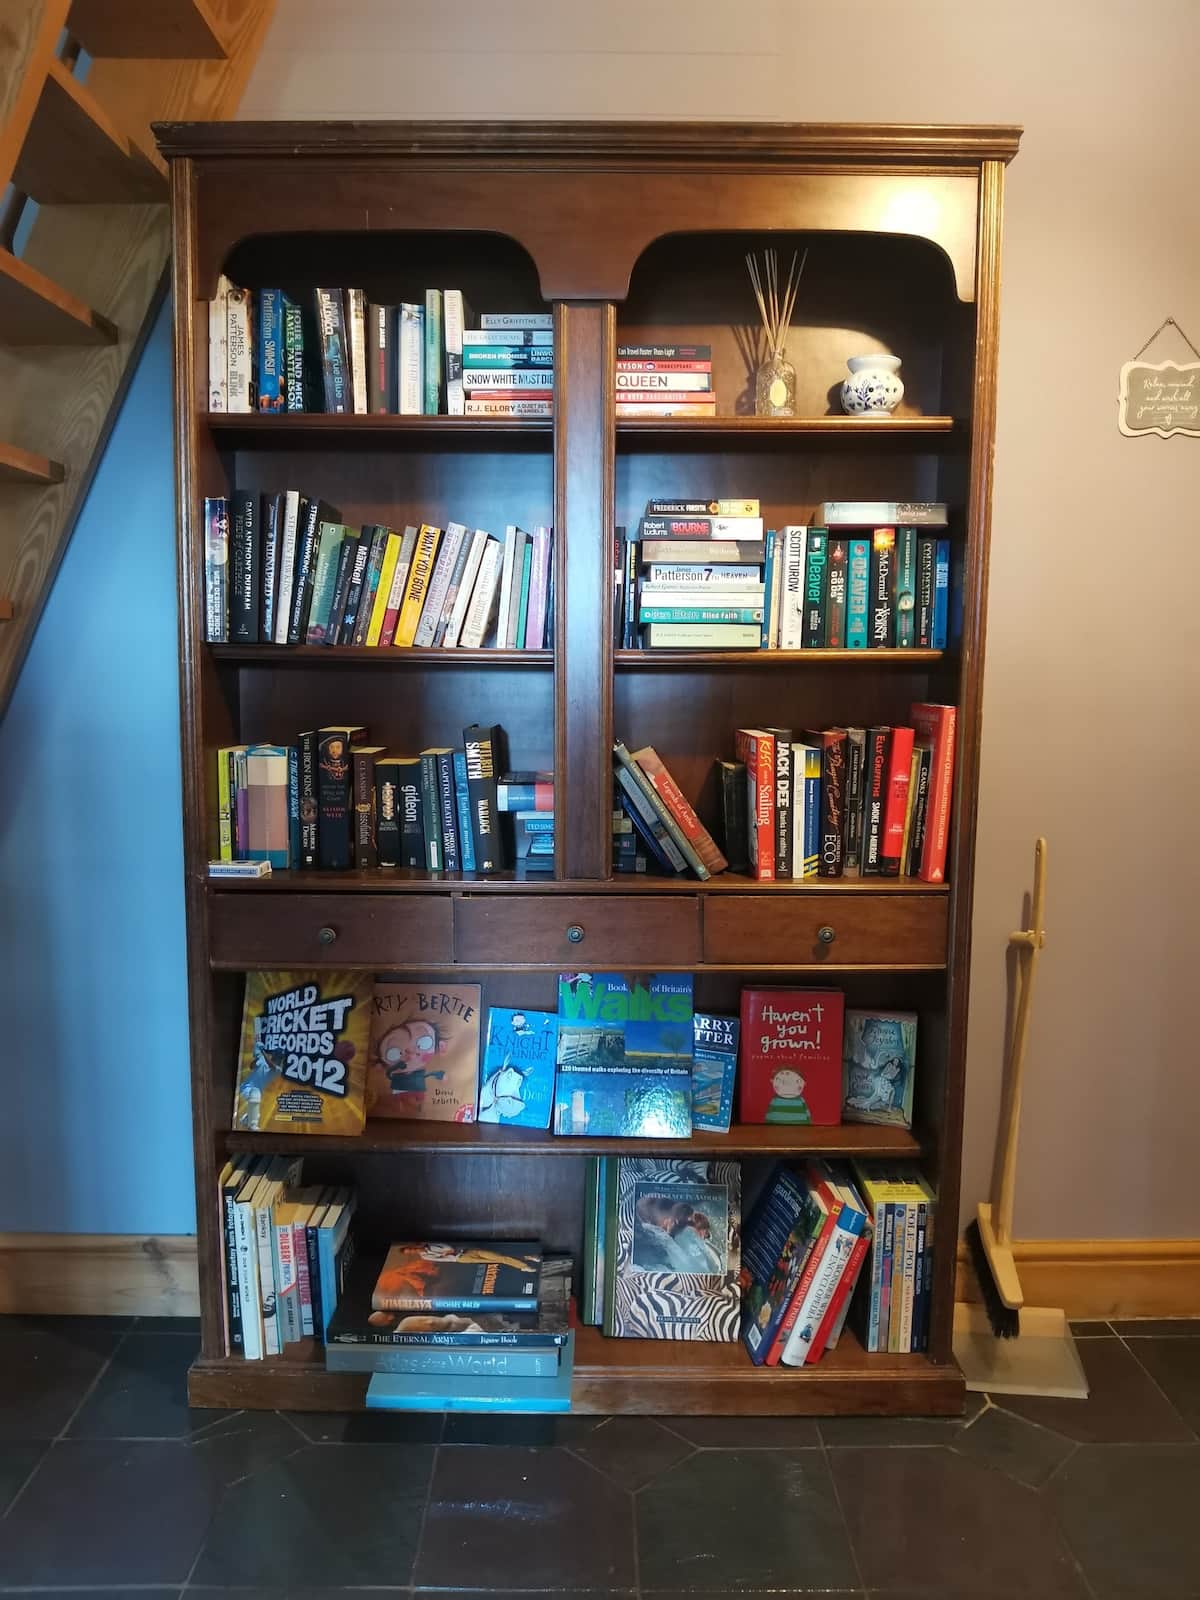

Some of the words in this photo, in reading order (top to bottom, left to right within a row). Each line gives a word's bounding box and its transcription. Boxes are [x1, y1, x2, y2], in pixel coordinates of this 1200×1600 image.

[264, 294, 276, 338] Patterson
[286, 309, 295, 344] JAMES
[294, 309, 302, 338] FOUR
[230, 314, 238, 366] PATTERSON
[264, 340, 276, 376] SWIMSUIT
[294, 344, 303, 378] BLIND
[288, 348, 296, 410] PATTERSON
[334, 376, 343, 398] Blue
[466, 374, 490, 384] SNOW
[492, 374, 517, 384] WHITE
[518, 374, 540, 384] MUST
[542, 374, 552, 384] DIE
[618, 376, 668, 387] QUEEN
[294, 381, 304, 410] MICE
[306, 506, 318, 538] STEPHEN
[672, 522, 709, 531] BOURNE
[302, 538, 313, 574] HAWKING
[422, 530, 436, 559] WANT
[790, 531, 801, 560] SCOTT
[923, 543, 931, 570] COLIN
[264, 541, 276, 597] KIDNAPPED
[352, 546, 367, 585] Mankell
[416, 559, 429, 578] YOU
[655, 568, 702, 581] Patterson
[788, 563, 800, 592] TUROW
[808, 550, 825, 604] Deaver
[878, 554, 889, 600] McDermid
[936, 562, 947, 588] DEAVER
[244, 574, 252, 610] DURHAM
[836, 577, 845, 603] SKIN
[852, 557, 870, 615] DEAVER
[922, 572, 930, 606] DEXTER
[874, 608, 884, 641] POINT
[479, 740, 493, 777] WILBUR
[777, 742, 789, 777] JACK
[876, 736, 886, 754] ELLY
[303, 752, 311, 773] IRON
[466, 742, 481, 779] SMITH
[304, 775, 312, 796] KING
[442, 765, 450, 798] CAPITOL
[777, 780, 789, 808] DEE
[401, 785, 420, 822] gideon
[444, 800, 452, 826] DEATH
[477, 799, 490, 835] WARLOCK
[757, 785, 772, 825] Sailing
[871, 802, 880, 824] SMOKE
[824, 834, 836, 864] ECO
[869, 836, 878, 864] MIRRORS
[268, 985, 318, 1014] WORLD
[560, 982, 693, 1023] Walks
[608, 984, 628, 992] Book
[662, 985, 692, 993] Britain's
[254, 998, 352, 1034] CRICKET
[417, 992, 474, 1023] BERTIE
[761, 1003, 824, 1024] Haven't
[264, 1032, 334, 1055] RECORDS
[761, 1030, 821, 1053] grown!
[777, 1024, 808, 1038] you
[285, 1054, 346, 1095] 2012
[907, 1207, 916, 1237] POLE
[280, 1234, 291, 1264] DILBERT
[825, 1261, 844, 1300] WONDER
[905, 1250, 913, 1282] POLE
[806, 1254, 839, 1320] ENCYCLOPEDIA
[814, 1299, 828, 1320] WHY
[373, 1335, 390, 1344] THE
[392, 1333, 430, 1344] ETERNAL
[431, 1334, 455, 1344] ARMY
[448, 1354, 507, 1374] World
